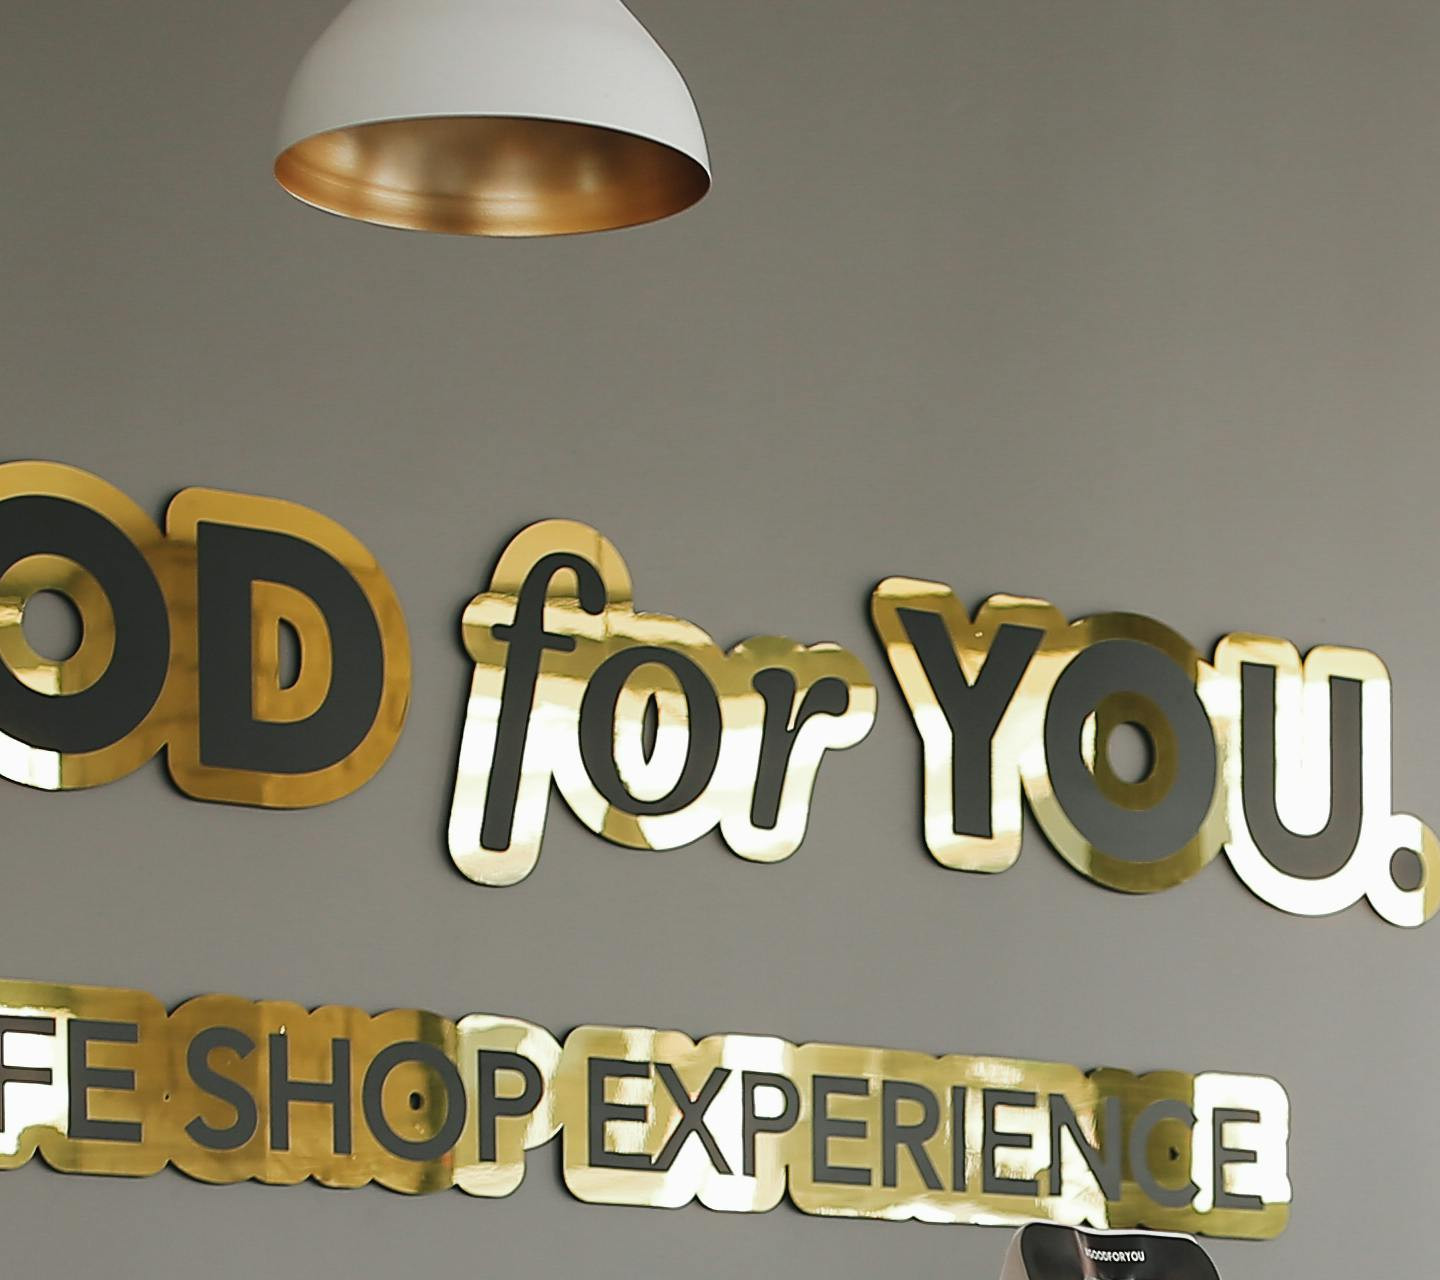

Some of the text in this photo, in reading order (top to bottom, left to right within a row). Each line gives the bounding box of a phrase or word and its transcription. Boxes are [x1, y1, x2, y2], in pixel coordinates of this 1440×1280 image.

[480, 550, 850, 852] for
[894, 605, 1426, 893] YOU.
[183, 1025, 545, 1164] SHOP
[586, 1057, 1263, 1211] EXPERIENCE
